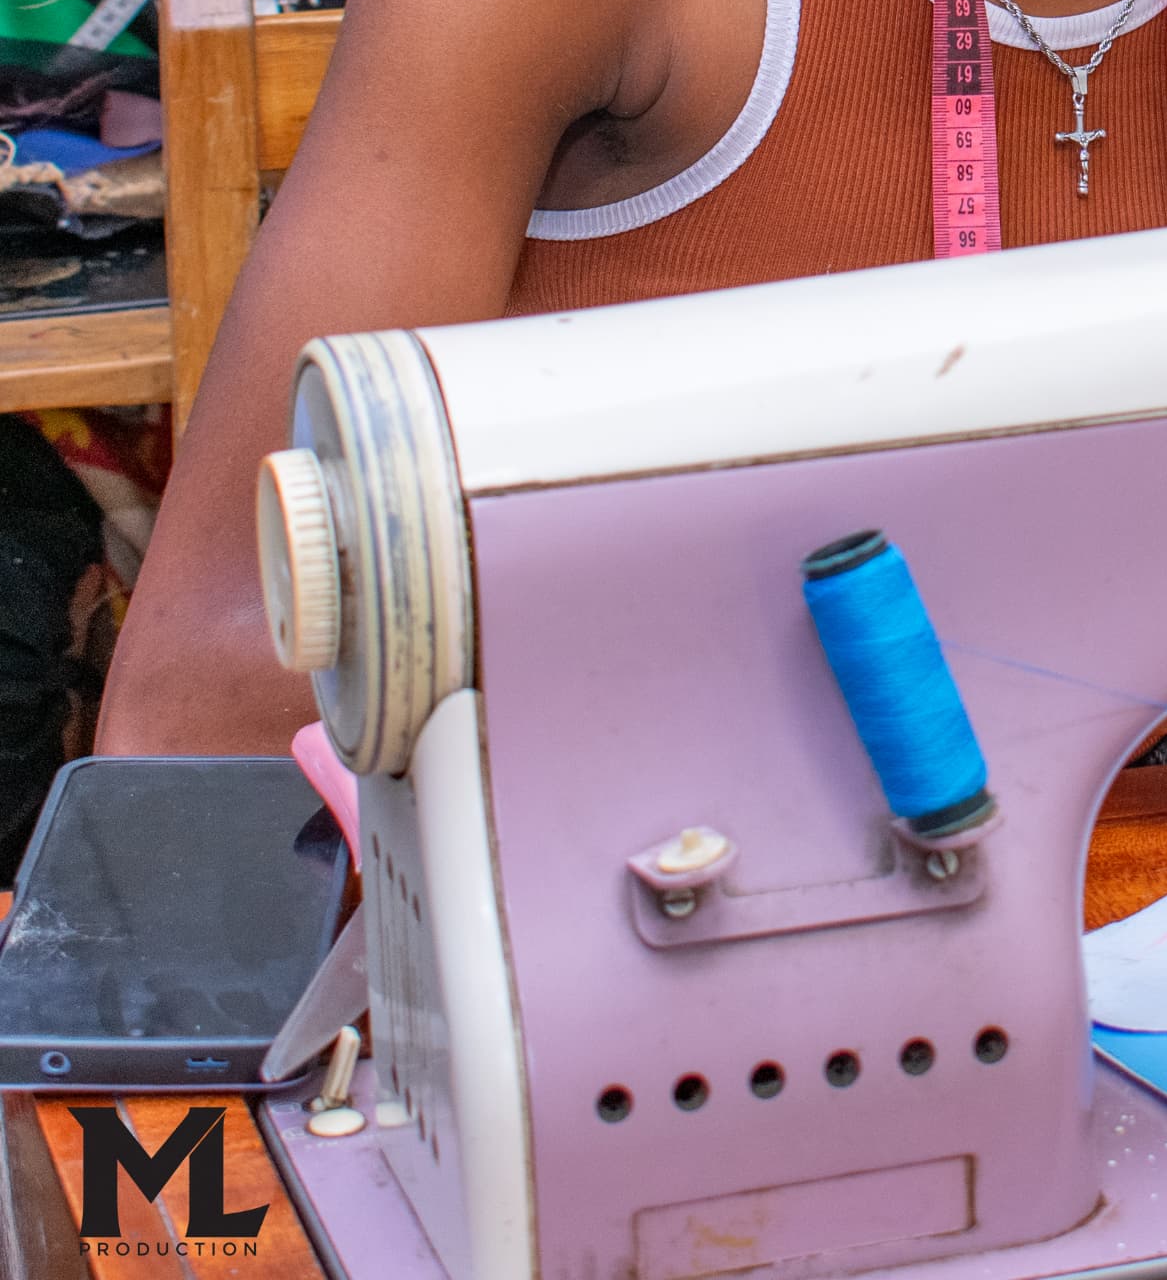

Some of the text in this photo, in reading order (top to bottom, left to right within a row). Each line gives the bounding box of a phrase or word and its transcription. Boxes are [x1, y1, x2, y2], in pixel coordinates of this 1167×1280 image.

[955, 0, 971, 17] 63
[956, 31, 973, 50] 62
[957, 65, 973, 83] 61
[955, 98, 972, 116] 60
[955, 131, 973, 148] 59
[956, 164, 973, 181] 58
[957, 197, 975, 215] 57
[958, 230, 976, 248] 56
